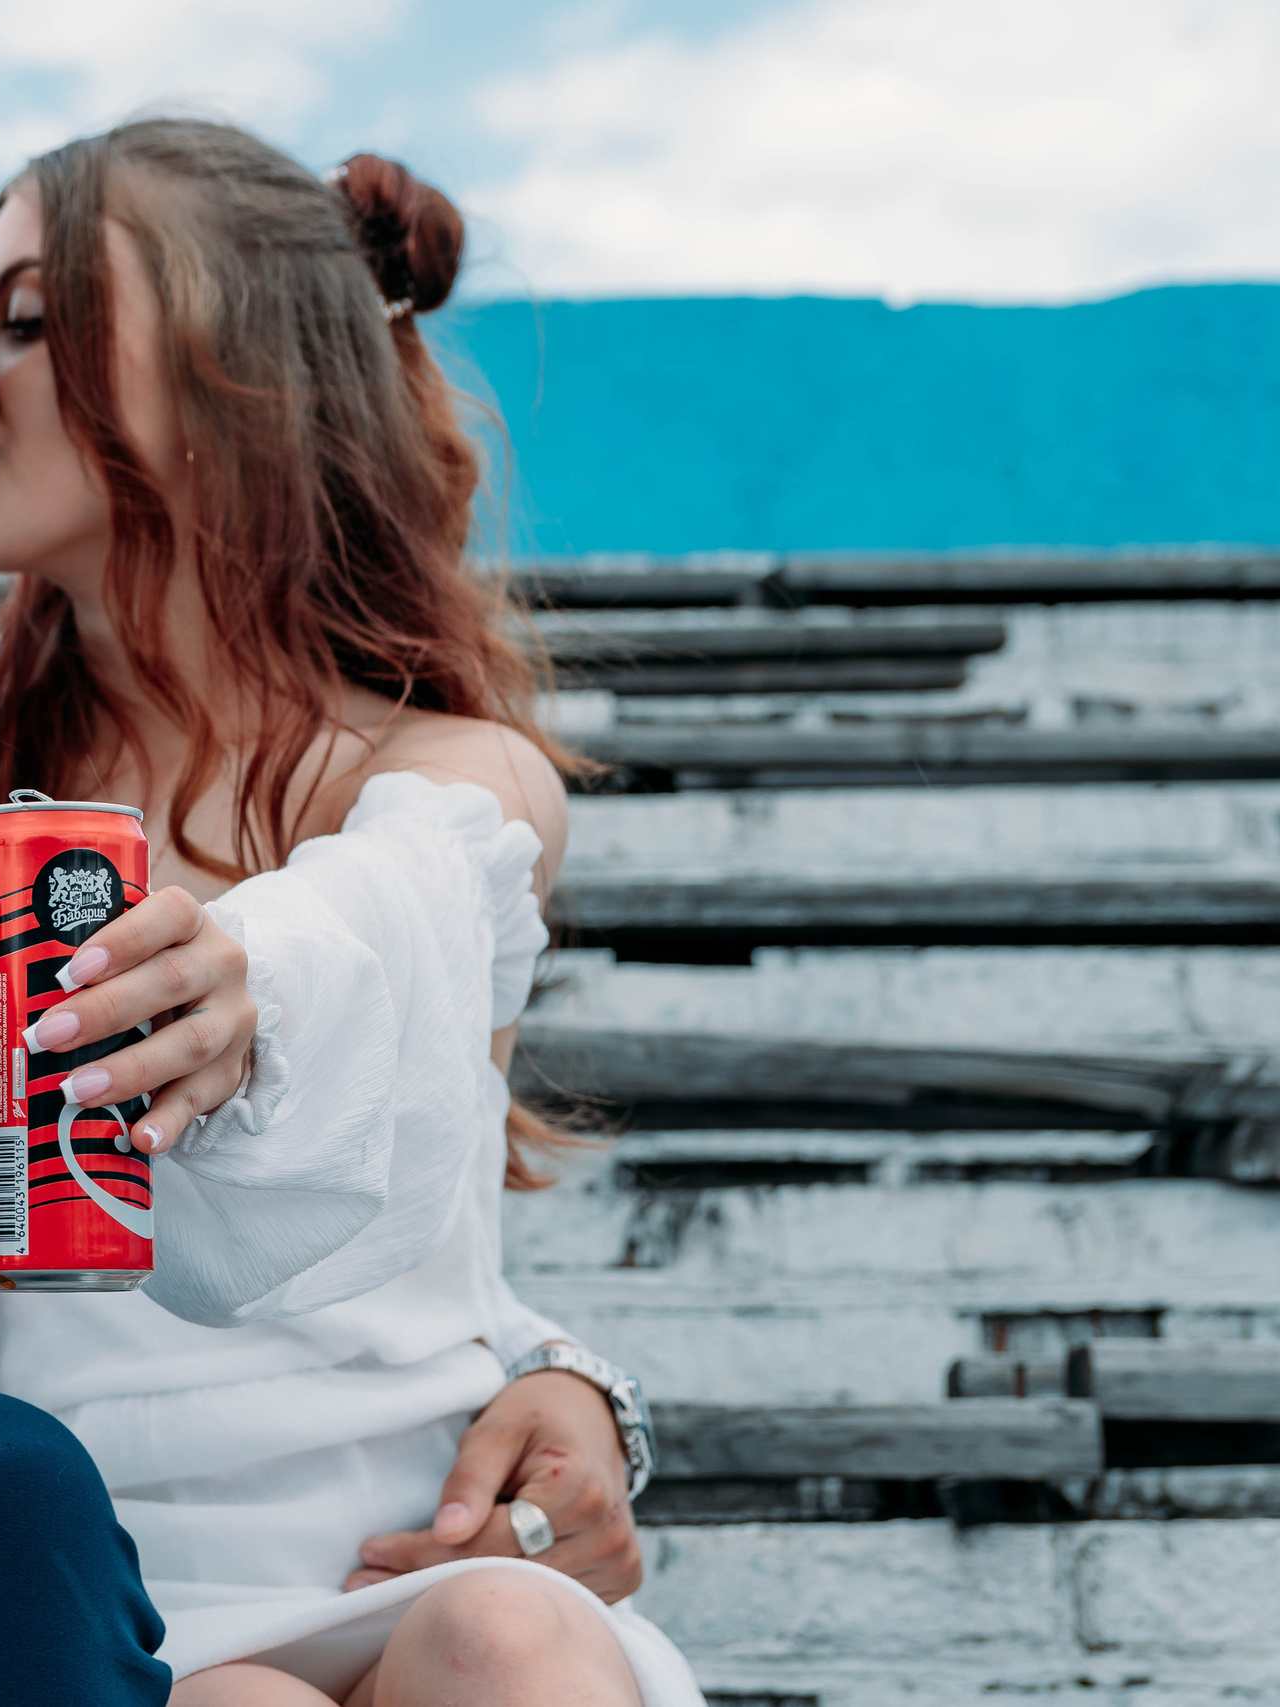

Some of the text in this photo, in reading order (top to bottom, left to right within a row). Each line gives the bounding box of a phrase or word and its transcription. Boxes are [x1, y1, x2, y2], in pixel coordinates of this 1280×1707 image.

[50, 904, 108, 928] Бавария
[16, 1140, 25, 1184] 196115
[16, 1191, 25, 1238] 640043
